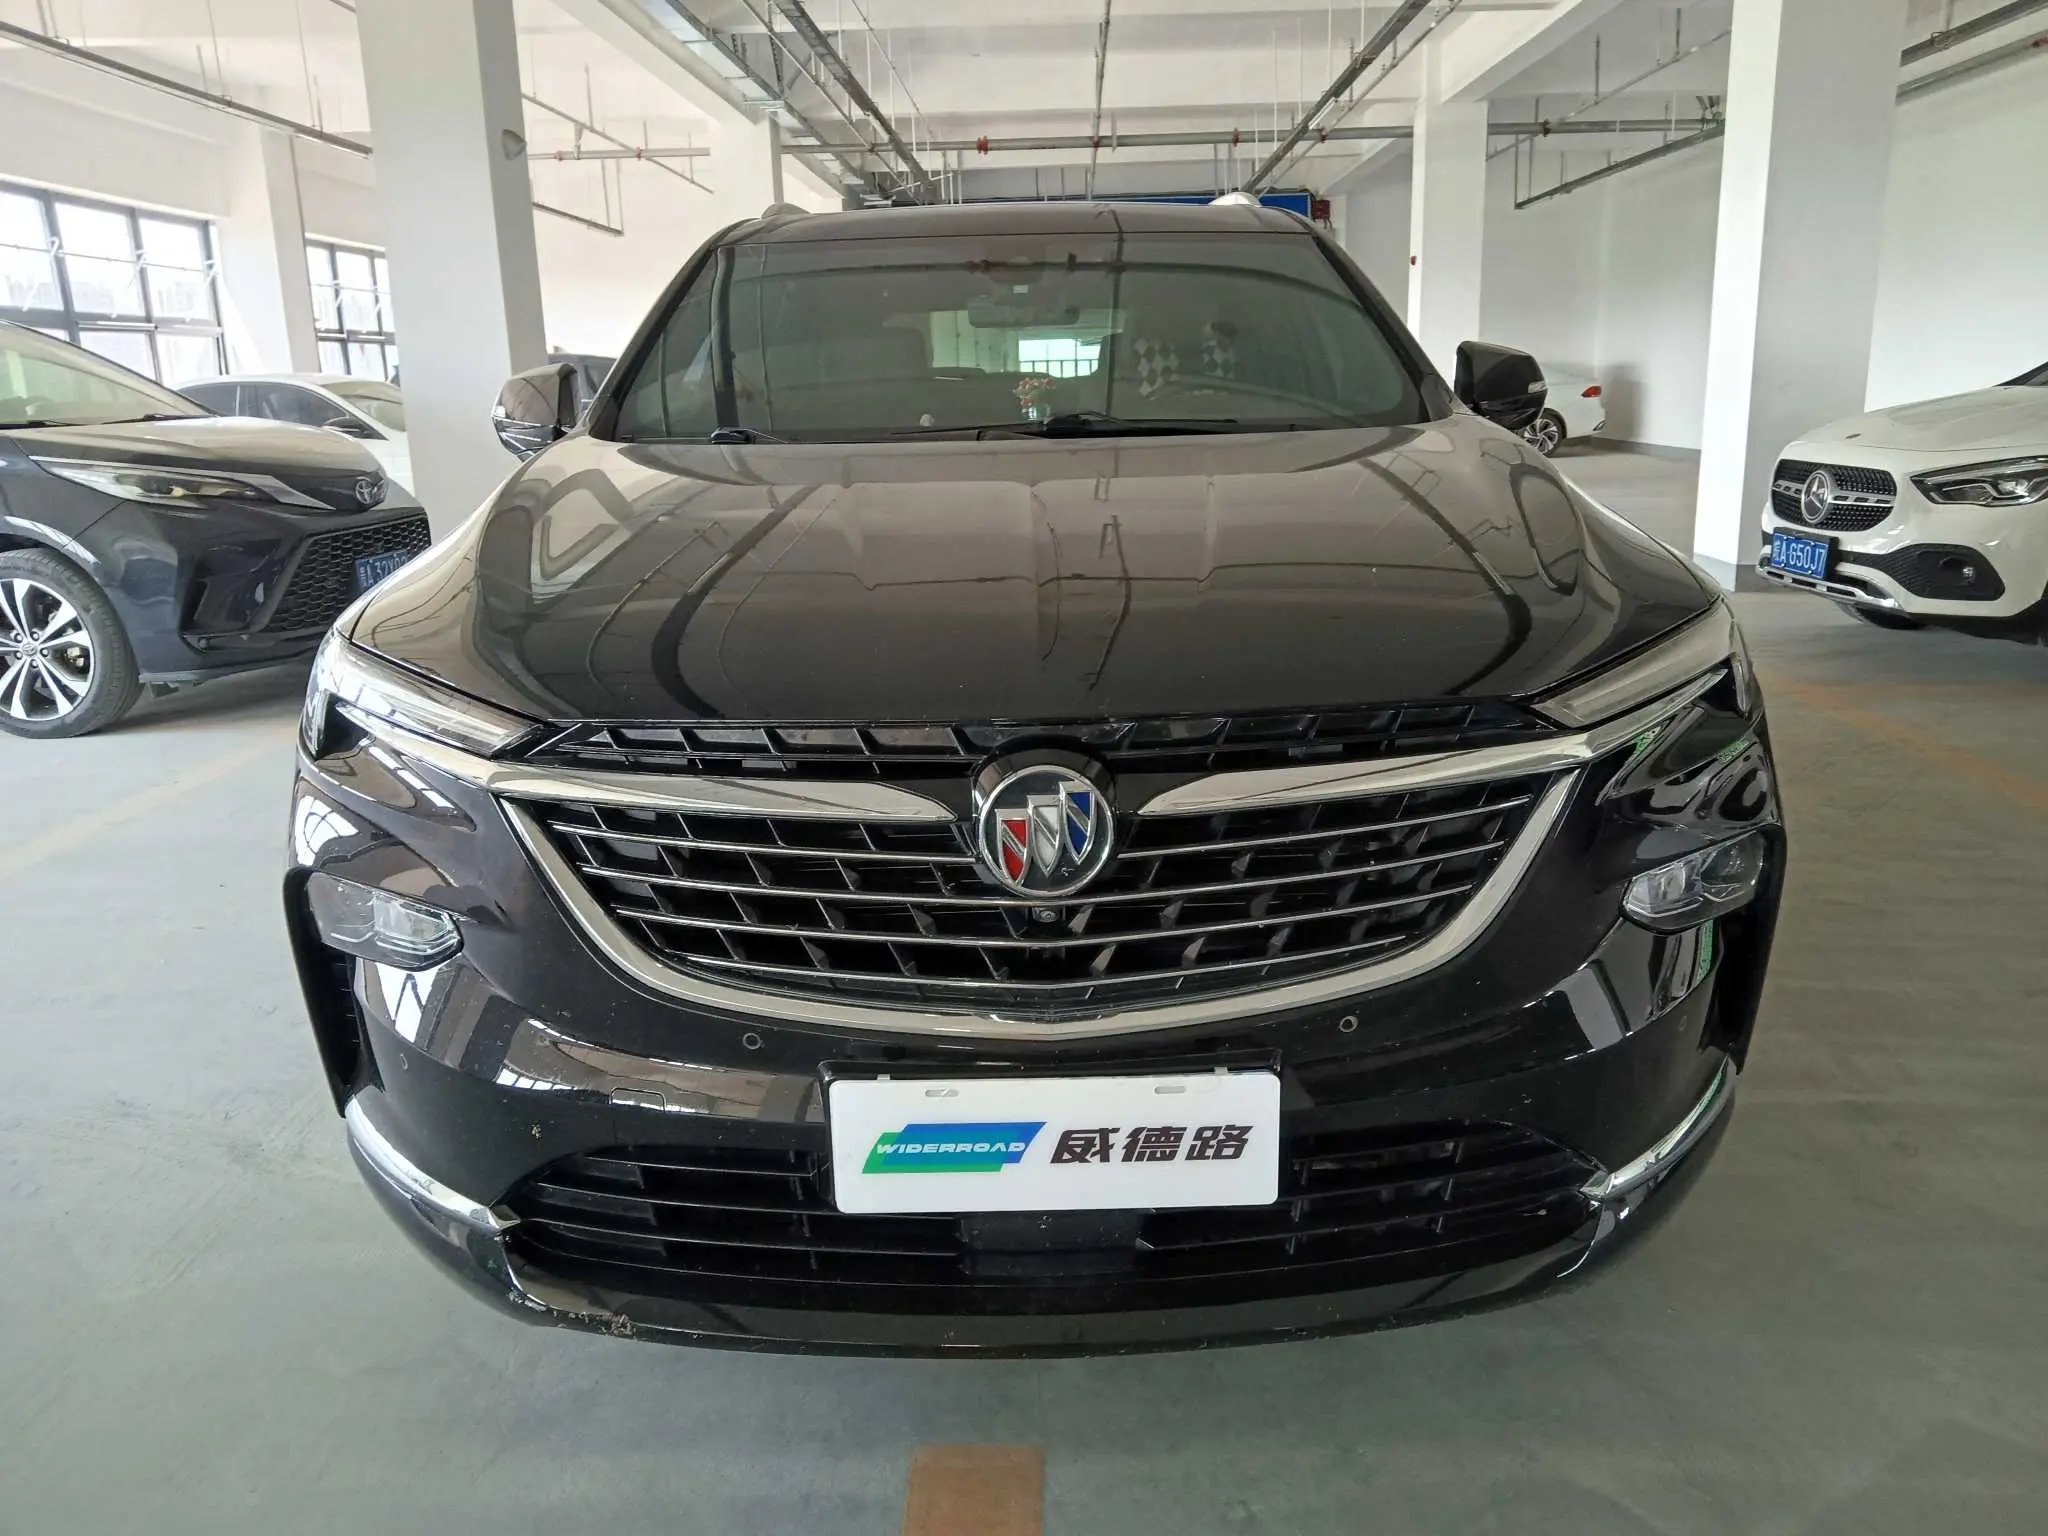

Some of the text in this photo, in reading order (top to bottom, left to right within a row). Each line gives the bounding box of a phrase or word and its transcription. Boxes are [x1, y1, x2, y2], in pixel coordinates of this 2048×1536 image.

[876, 1142, 1027, 1154] WIDERROAD
[1050, 1124, 1254, 1164] 威德路
